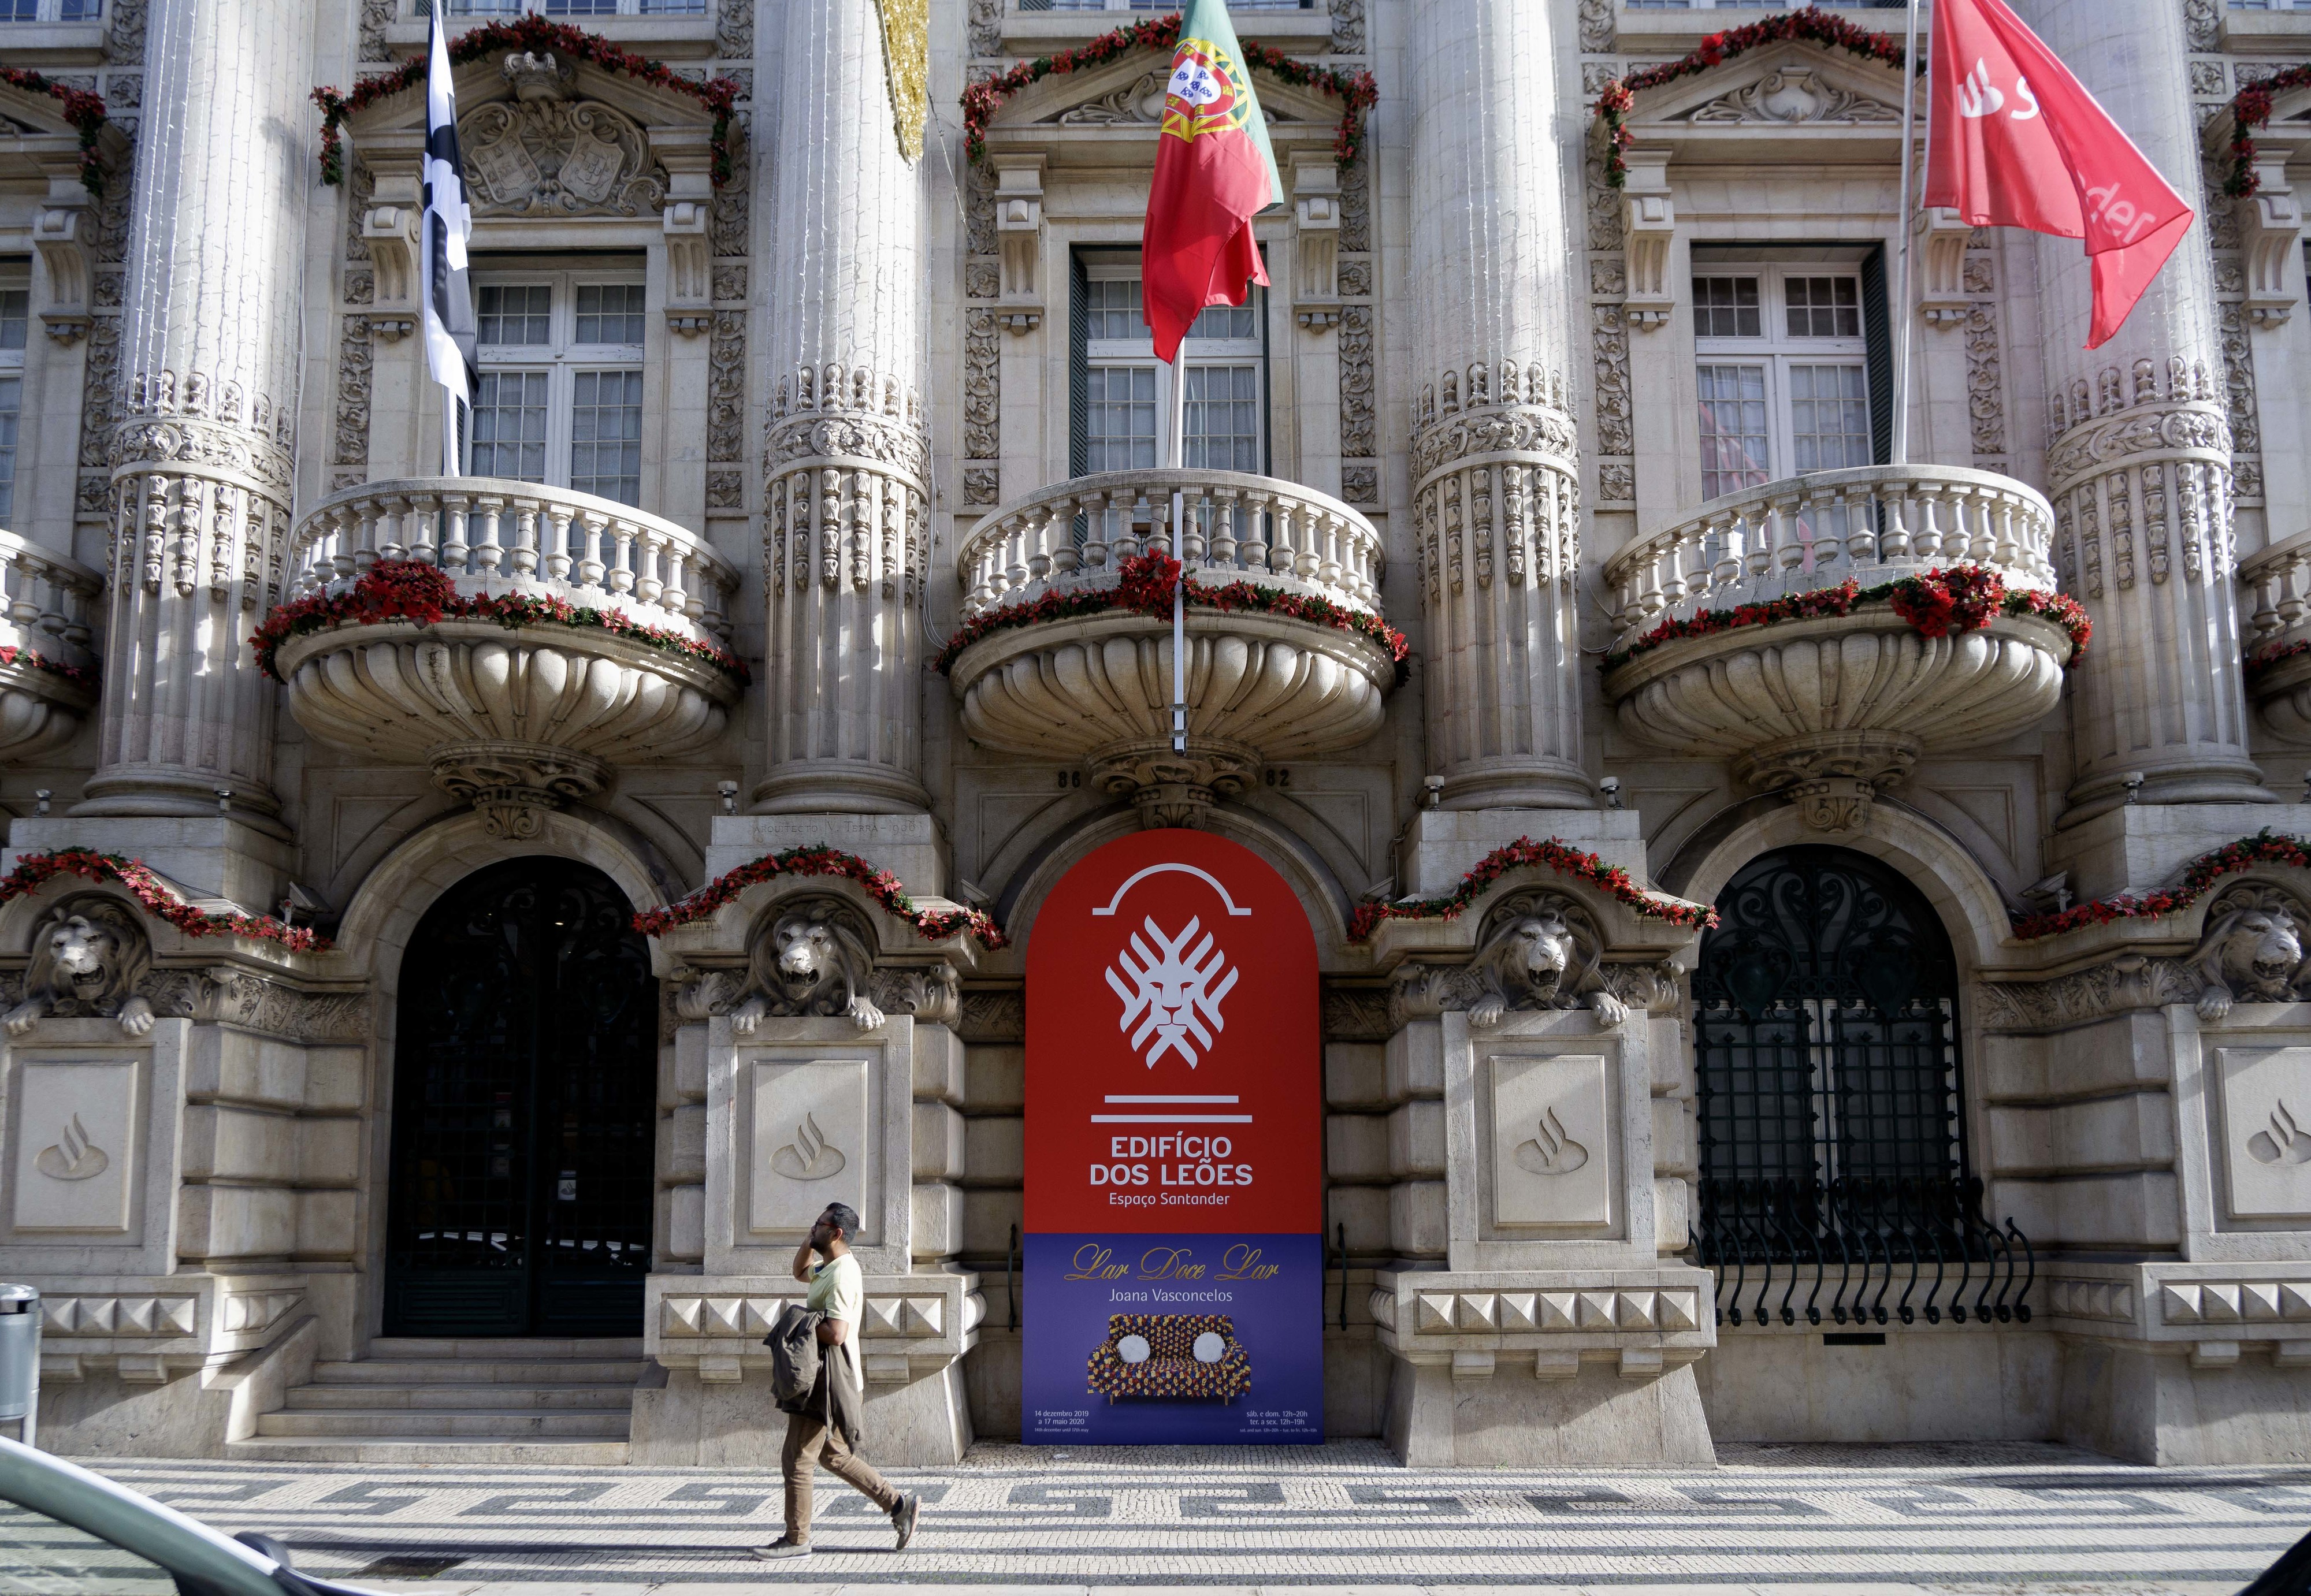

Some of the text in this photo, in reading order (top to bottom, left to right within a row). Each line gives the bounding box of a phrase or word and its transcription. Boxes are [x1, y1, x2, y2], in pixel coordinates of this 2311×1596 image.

[1058, 771, 1080, 788] 86
[1266, 769, 1289, 786] 82
[1112, 1131, 1231, 1157] EDIFÍCIO
[1091, 1158, 1252, 1185] DOS LEÕES
[1110, 1193, 1229, 1207] Espaço Santander
[1064, 1244, 1279, 1280] Lar Doce Lar
[1109, 1289, 1232, 1301] Joana Vasconcelos
